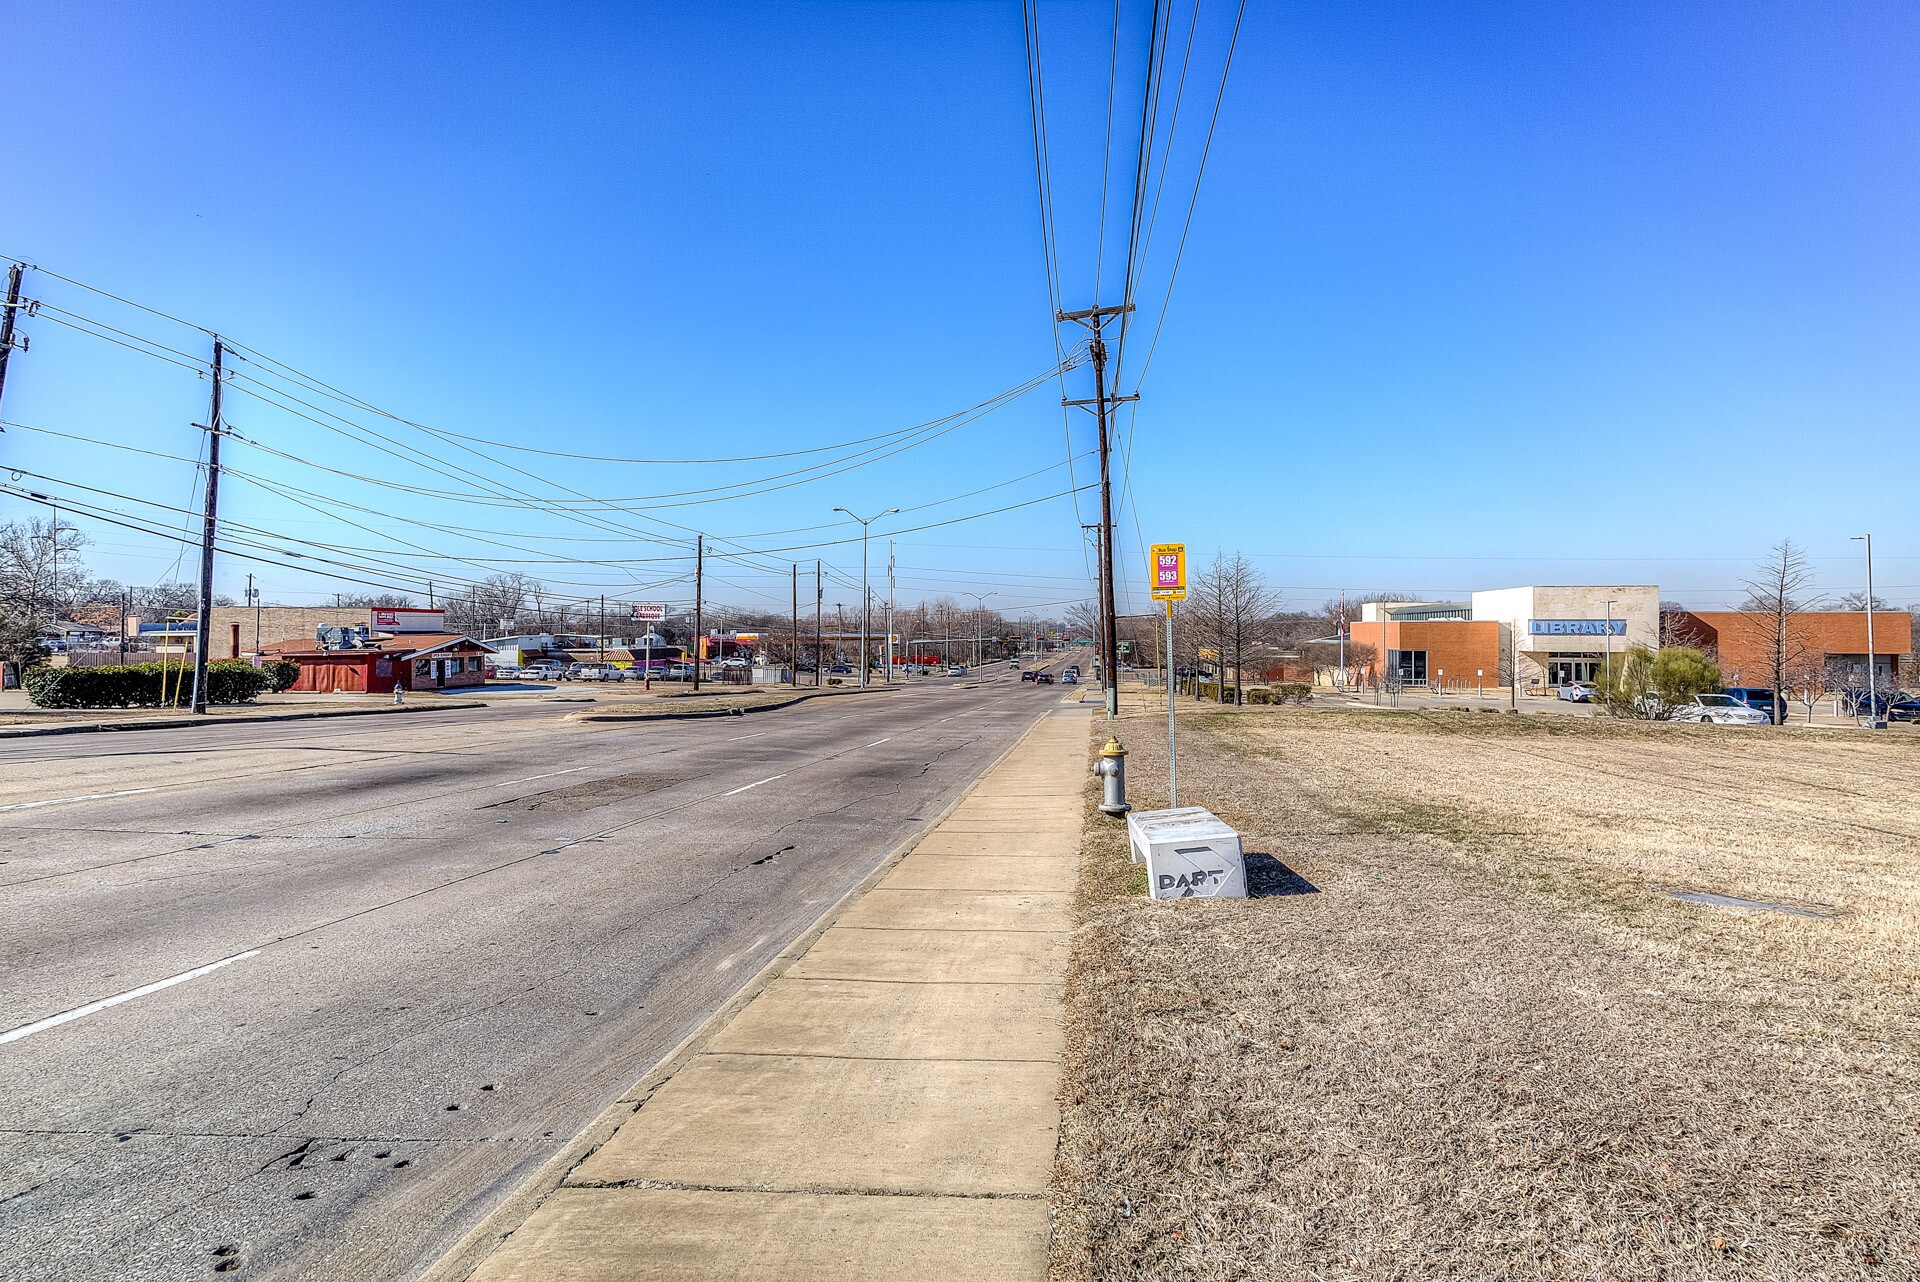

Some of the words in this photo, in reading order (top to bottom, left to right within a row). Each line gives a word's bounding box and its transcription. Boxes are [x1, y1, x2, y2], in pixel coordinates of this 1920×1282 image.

[1159, 555, 1177, 565] 592
[1159, 571, 1177, 581] 593
[1531, 619, 1626, 634] LIBRARY
[1159, 869, 1224, 890] DART
